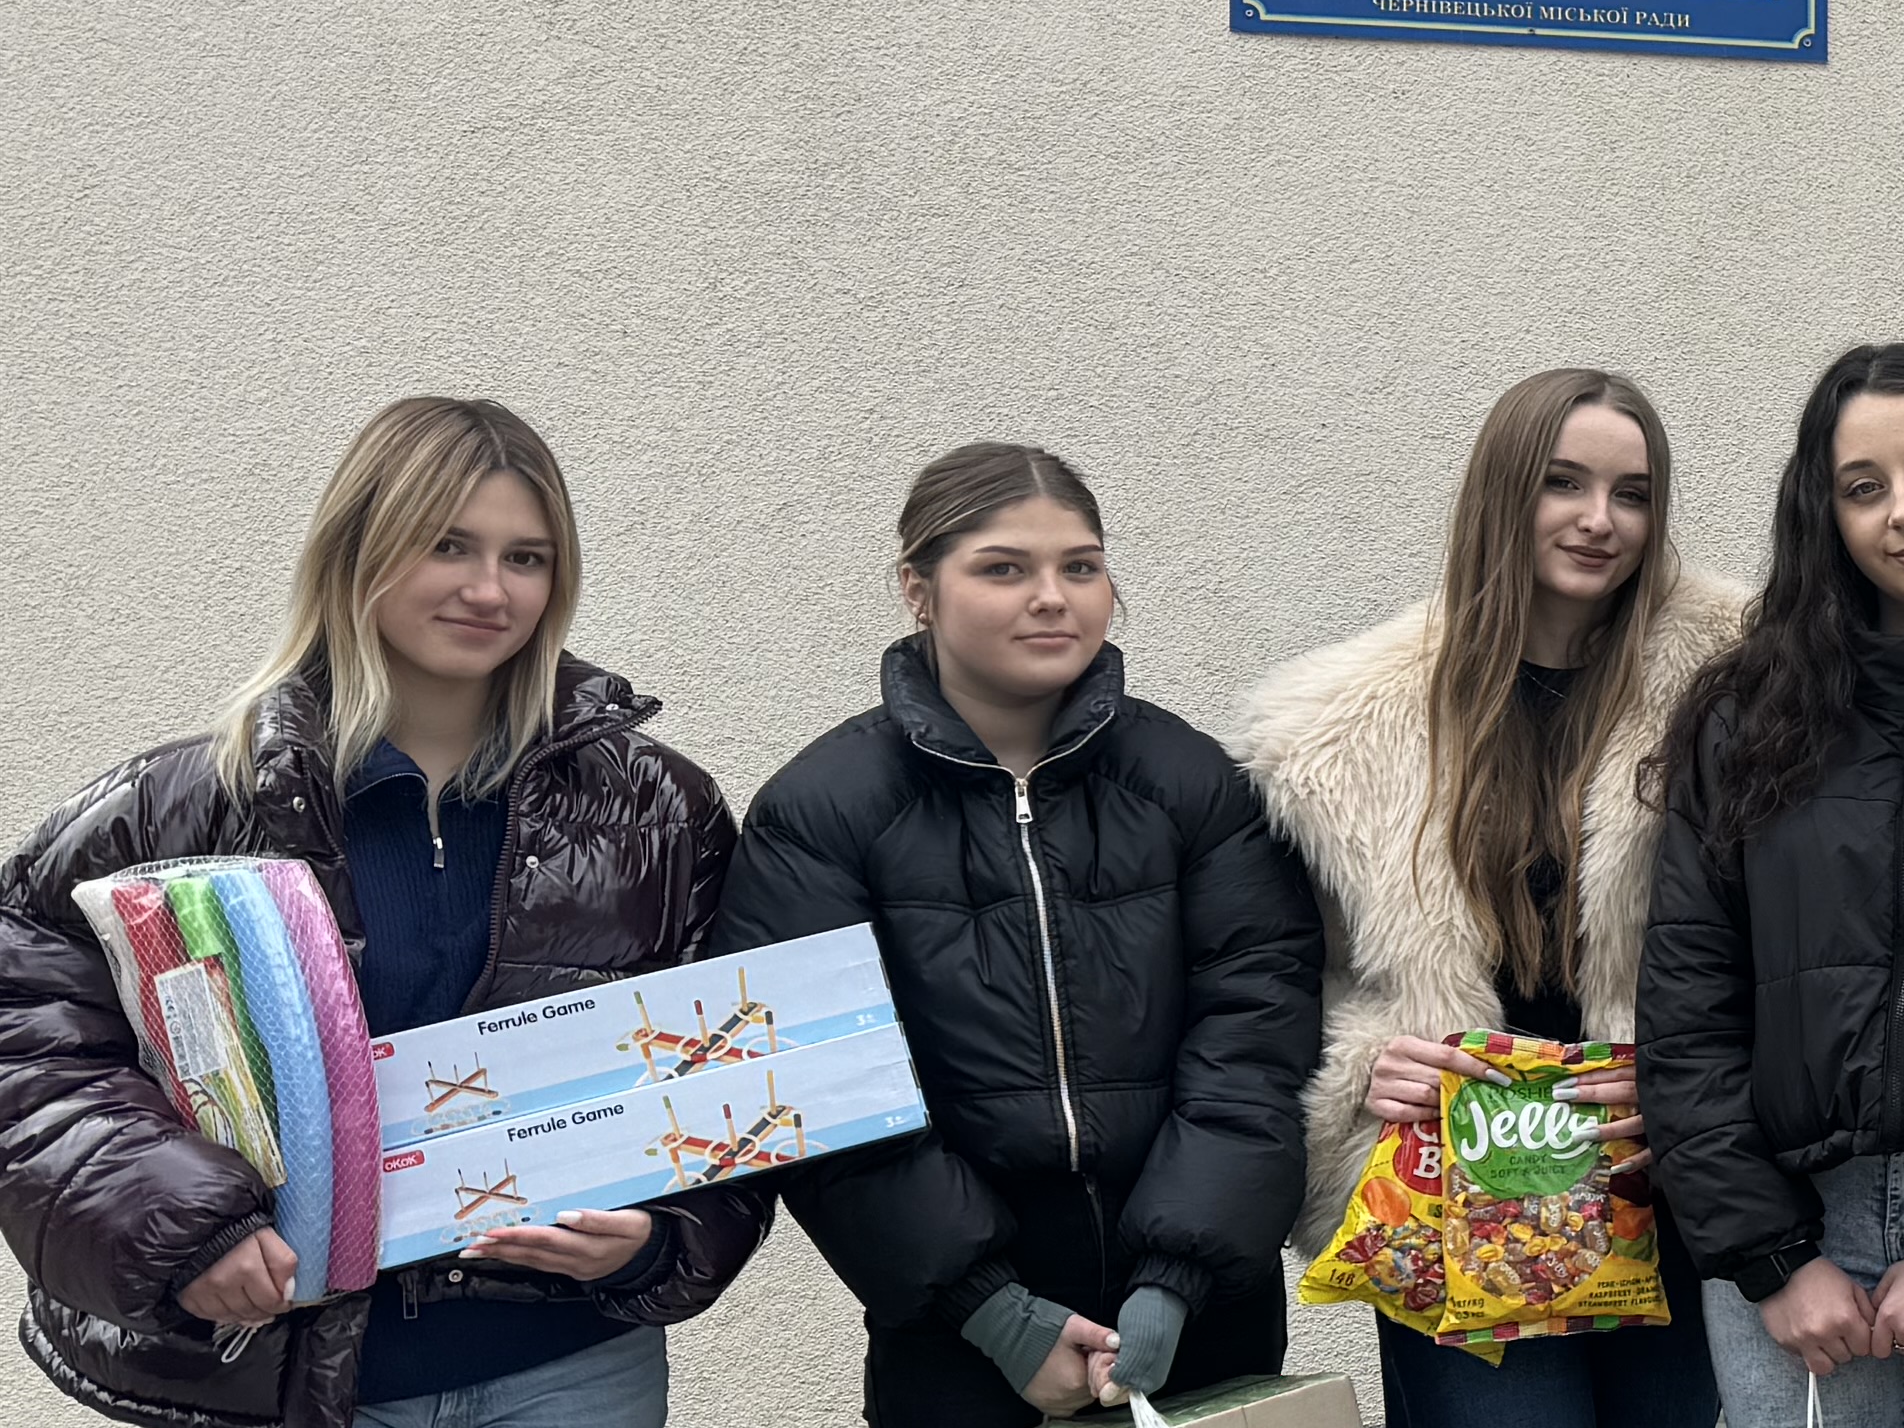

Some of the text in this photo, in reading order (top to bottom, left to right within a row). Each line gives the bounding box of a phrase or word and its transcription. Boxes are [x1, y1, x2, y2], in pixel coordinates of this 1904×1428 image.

[1539, 5, 1628, 25] МІСЬКОЇ
[1635, 10, 1690, 29] РАДИ
[477, 997, 596, 1036] Ferrule Game
[506, 1102, 625, 1143] Ferrule Game
[1460, 1101, 1598, 1161] Jelly
[1509, 1153, 1548, 1165] CANDY
